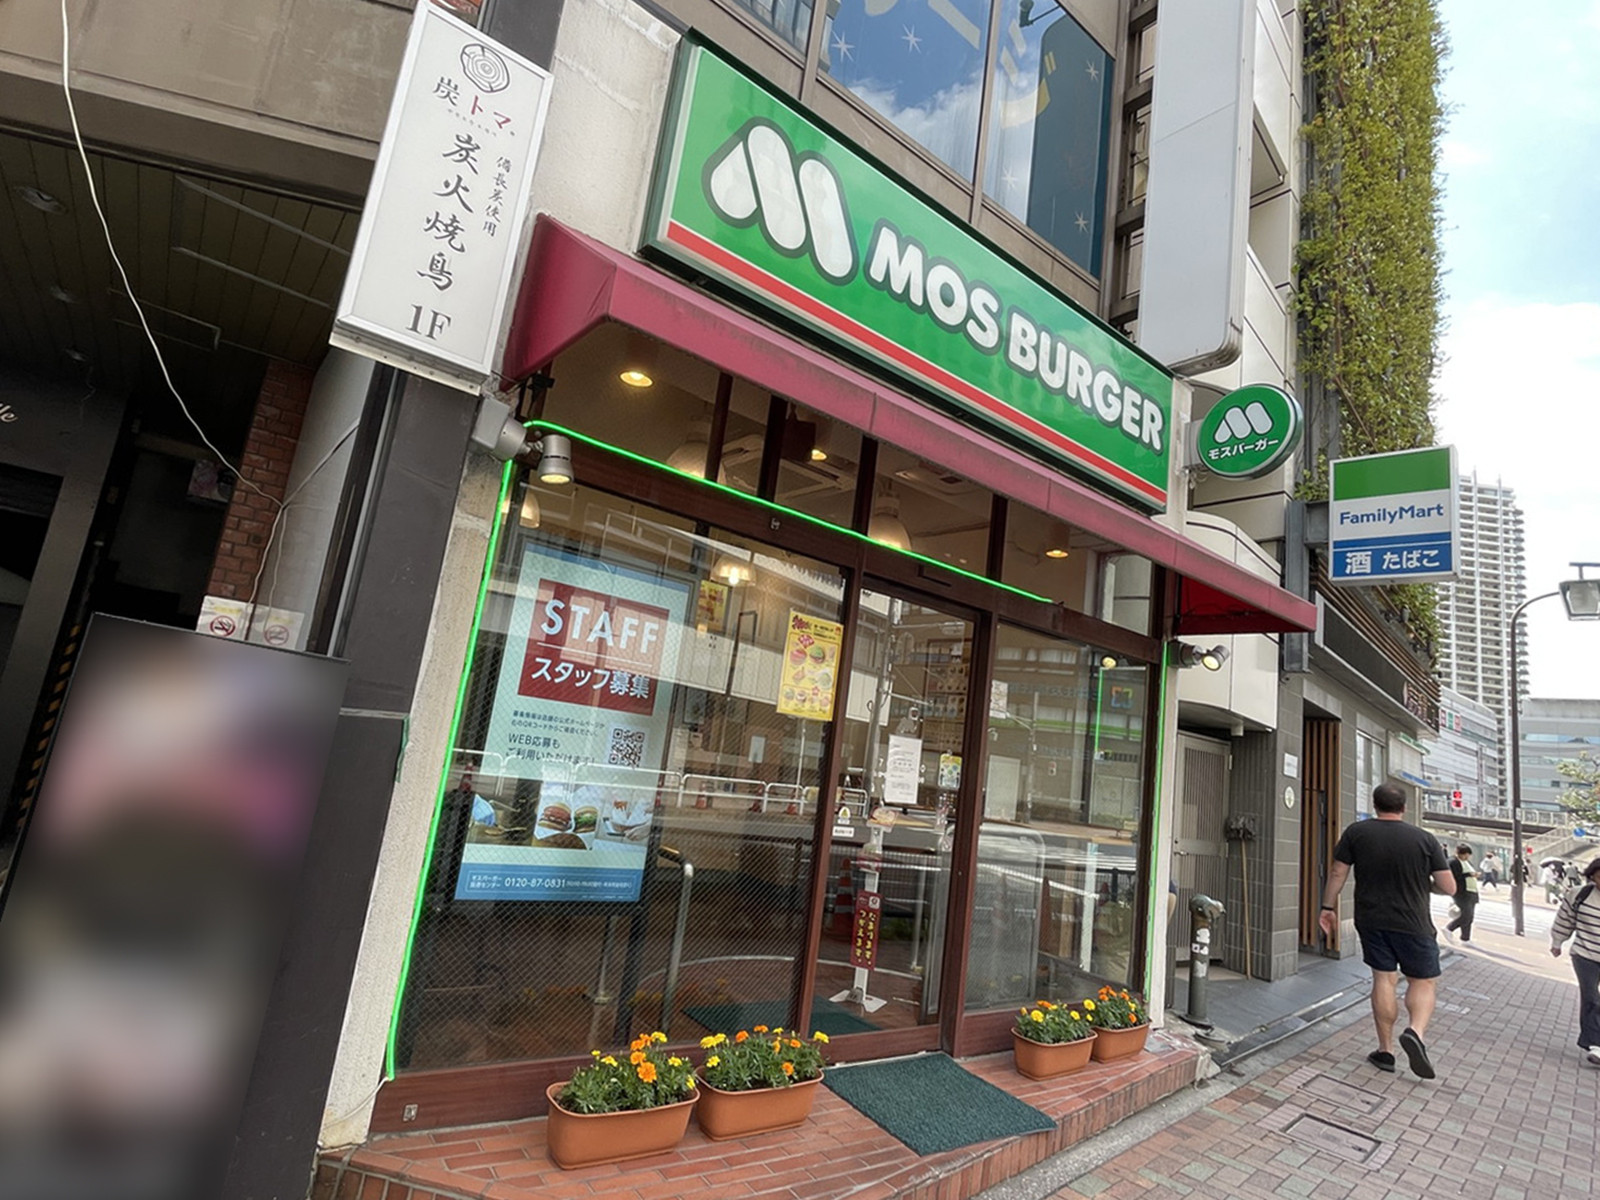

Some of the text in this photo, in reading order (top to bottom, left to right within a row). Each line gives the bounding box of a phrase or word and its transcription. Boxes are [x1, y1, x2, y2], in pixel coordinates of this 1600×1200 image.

[416, 133, 481, 291] 炭火焼鳥
[482, 156, 512, 237] 備長炭使用
[406, 303, 451, 340] 1F
[868, 223, 1165, 452] MOS BURGER
[1208, 437, 1279, 460] モスバーガー
[1340, 503, 1444, 526] FamilyMart
[1345, 549, 1441, 575] 酒 たばこ
[541, 599, 660, 654] STAFF
[531, 657, 650, 699] スタッフ募集
[508, 733, 560, 749] WEB応募も
